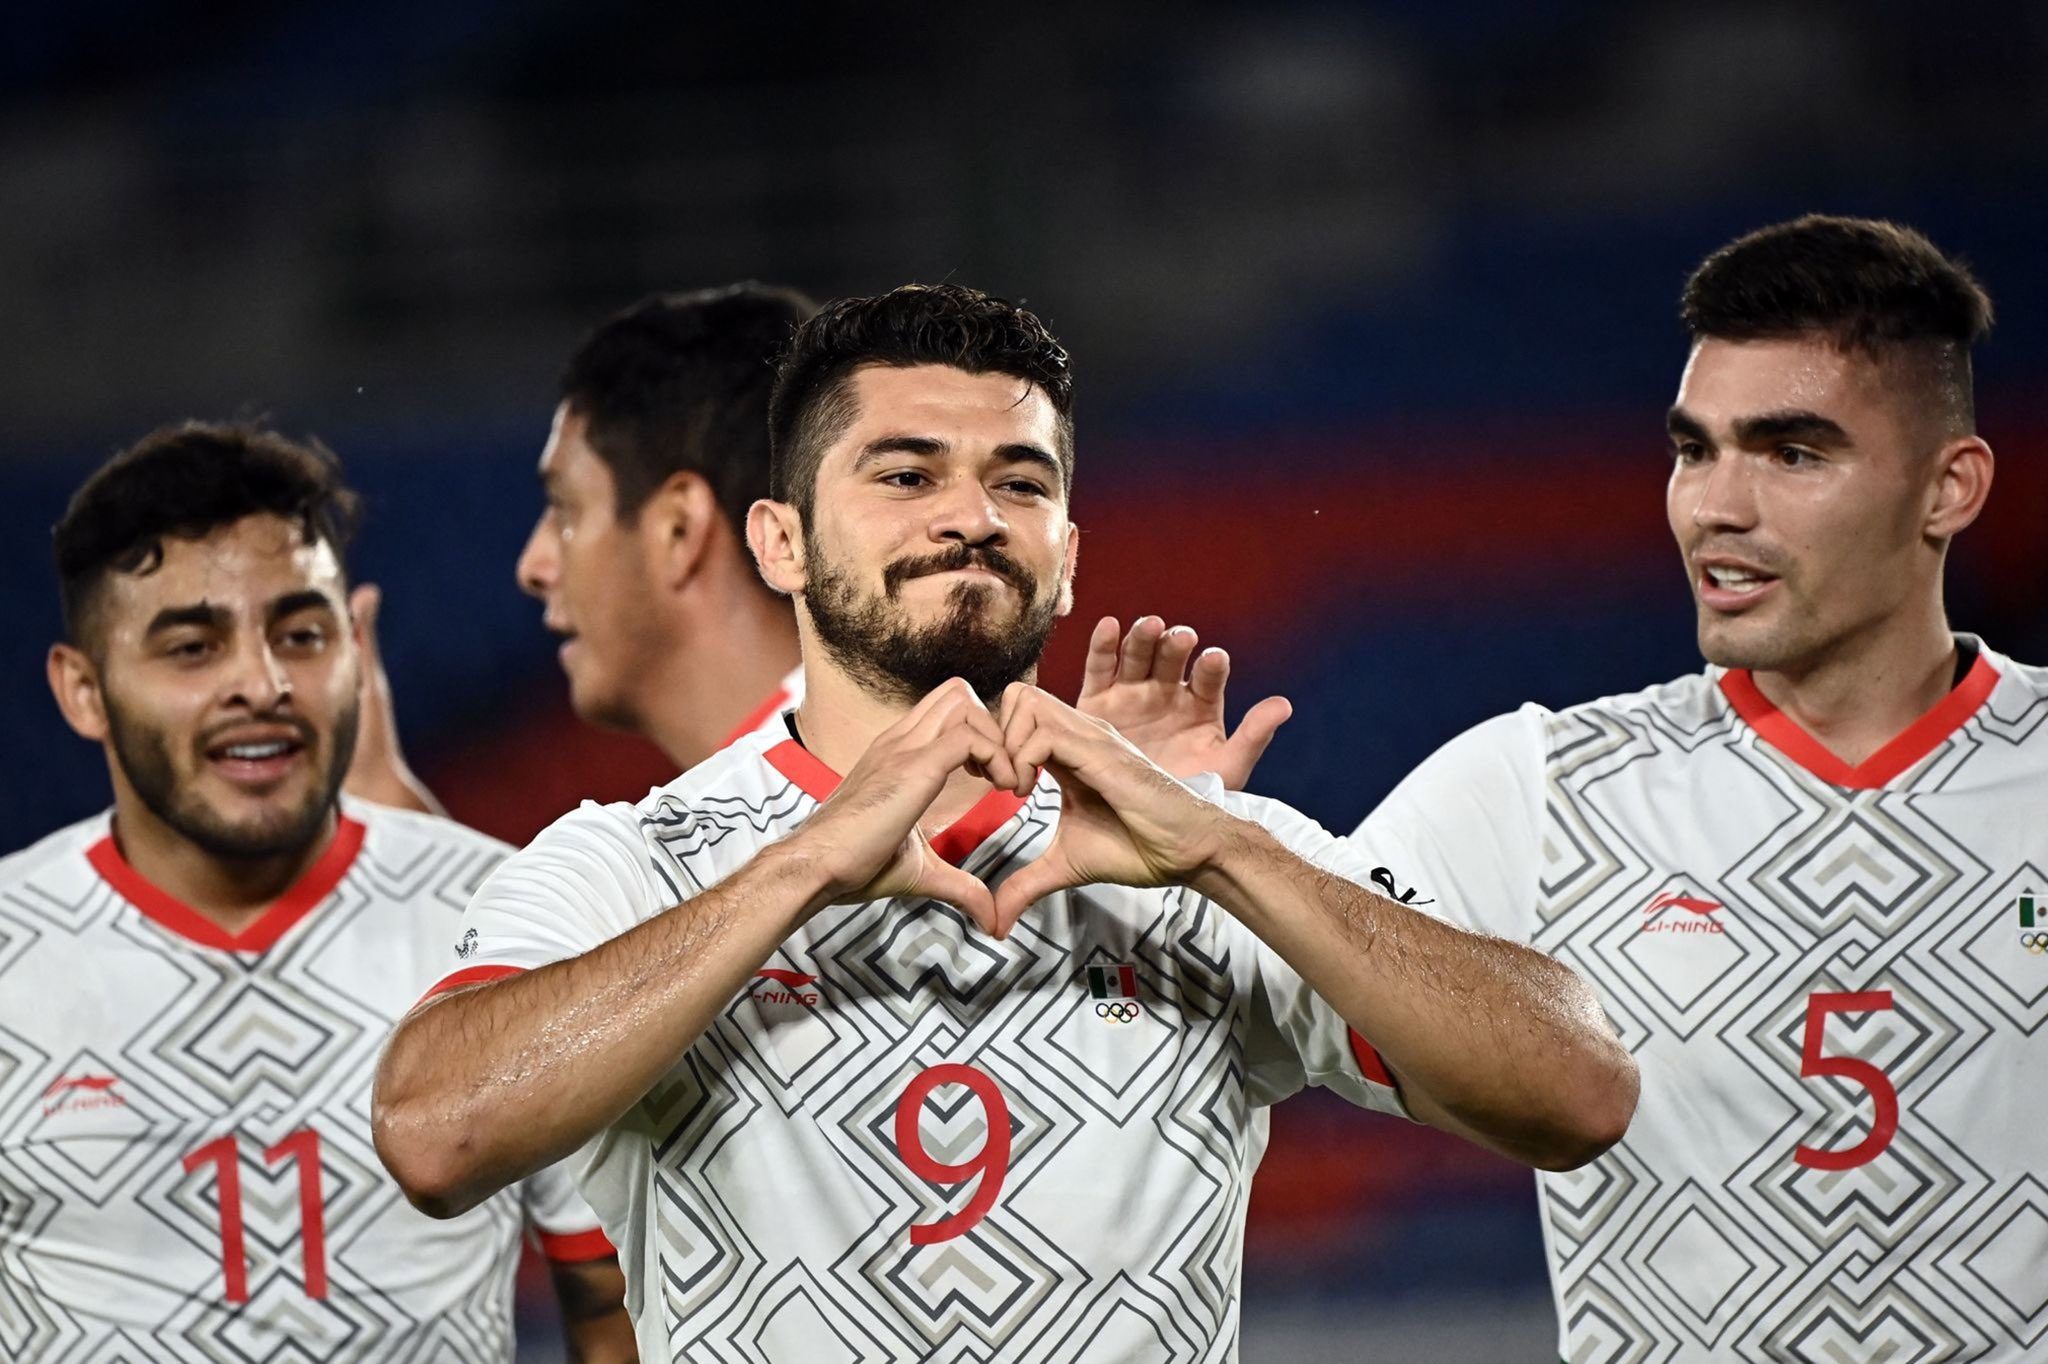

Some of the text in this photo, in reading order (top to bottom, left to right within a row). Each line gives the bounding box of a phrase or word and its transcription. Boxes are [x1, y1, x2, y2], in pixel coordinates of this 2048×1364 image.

[1642, 920, 1726, 934] LI-NING
[895, 1063, 1012, 1246] 9
[1794, 990, 1898, 1172] 5
[182, 1128, 328, 1304] 11
